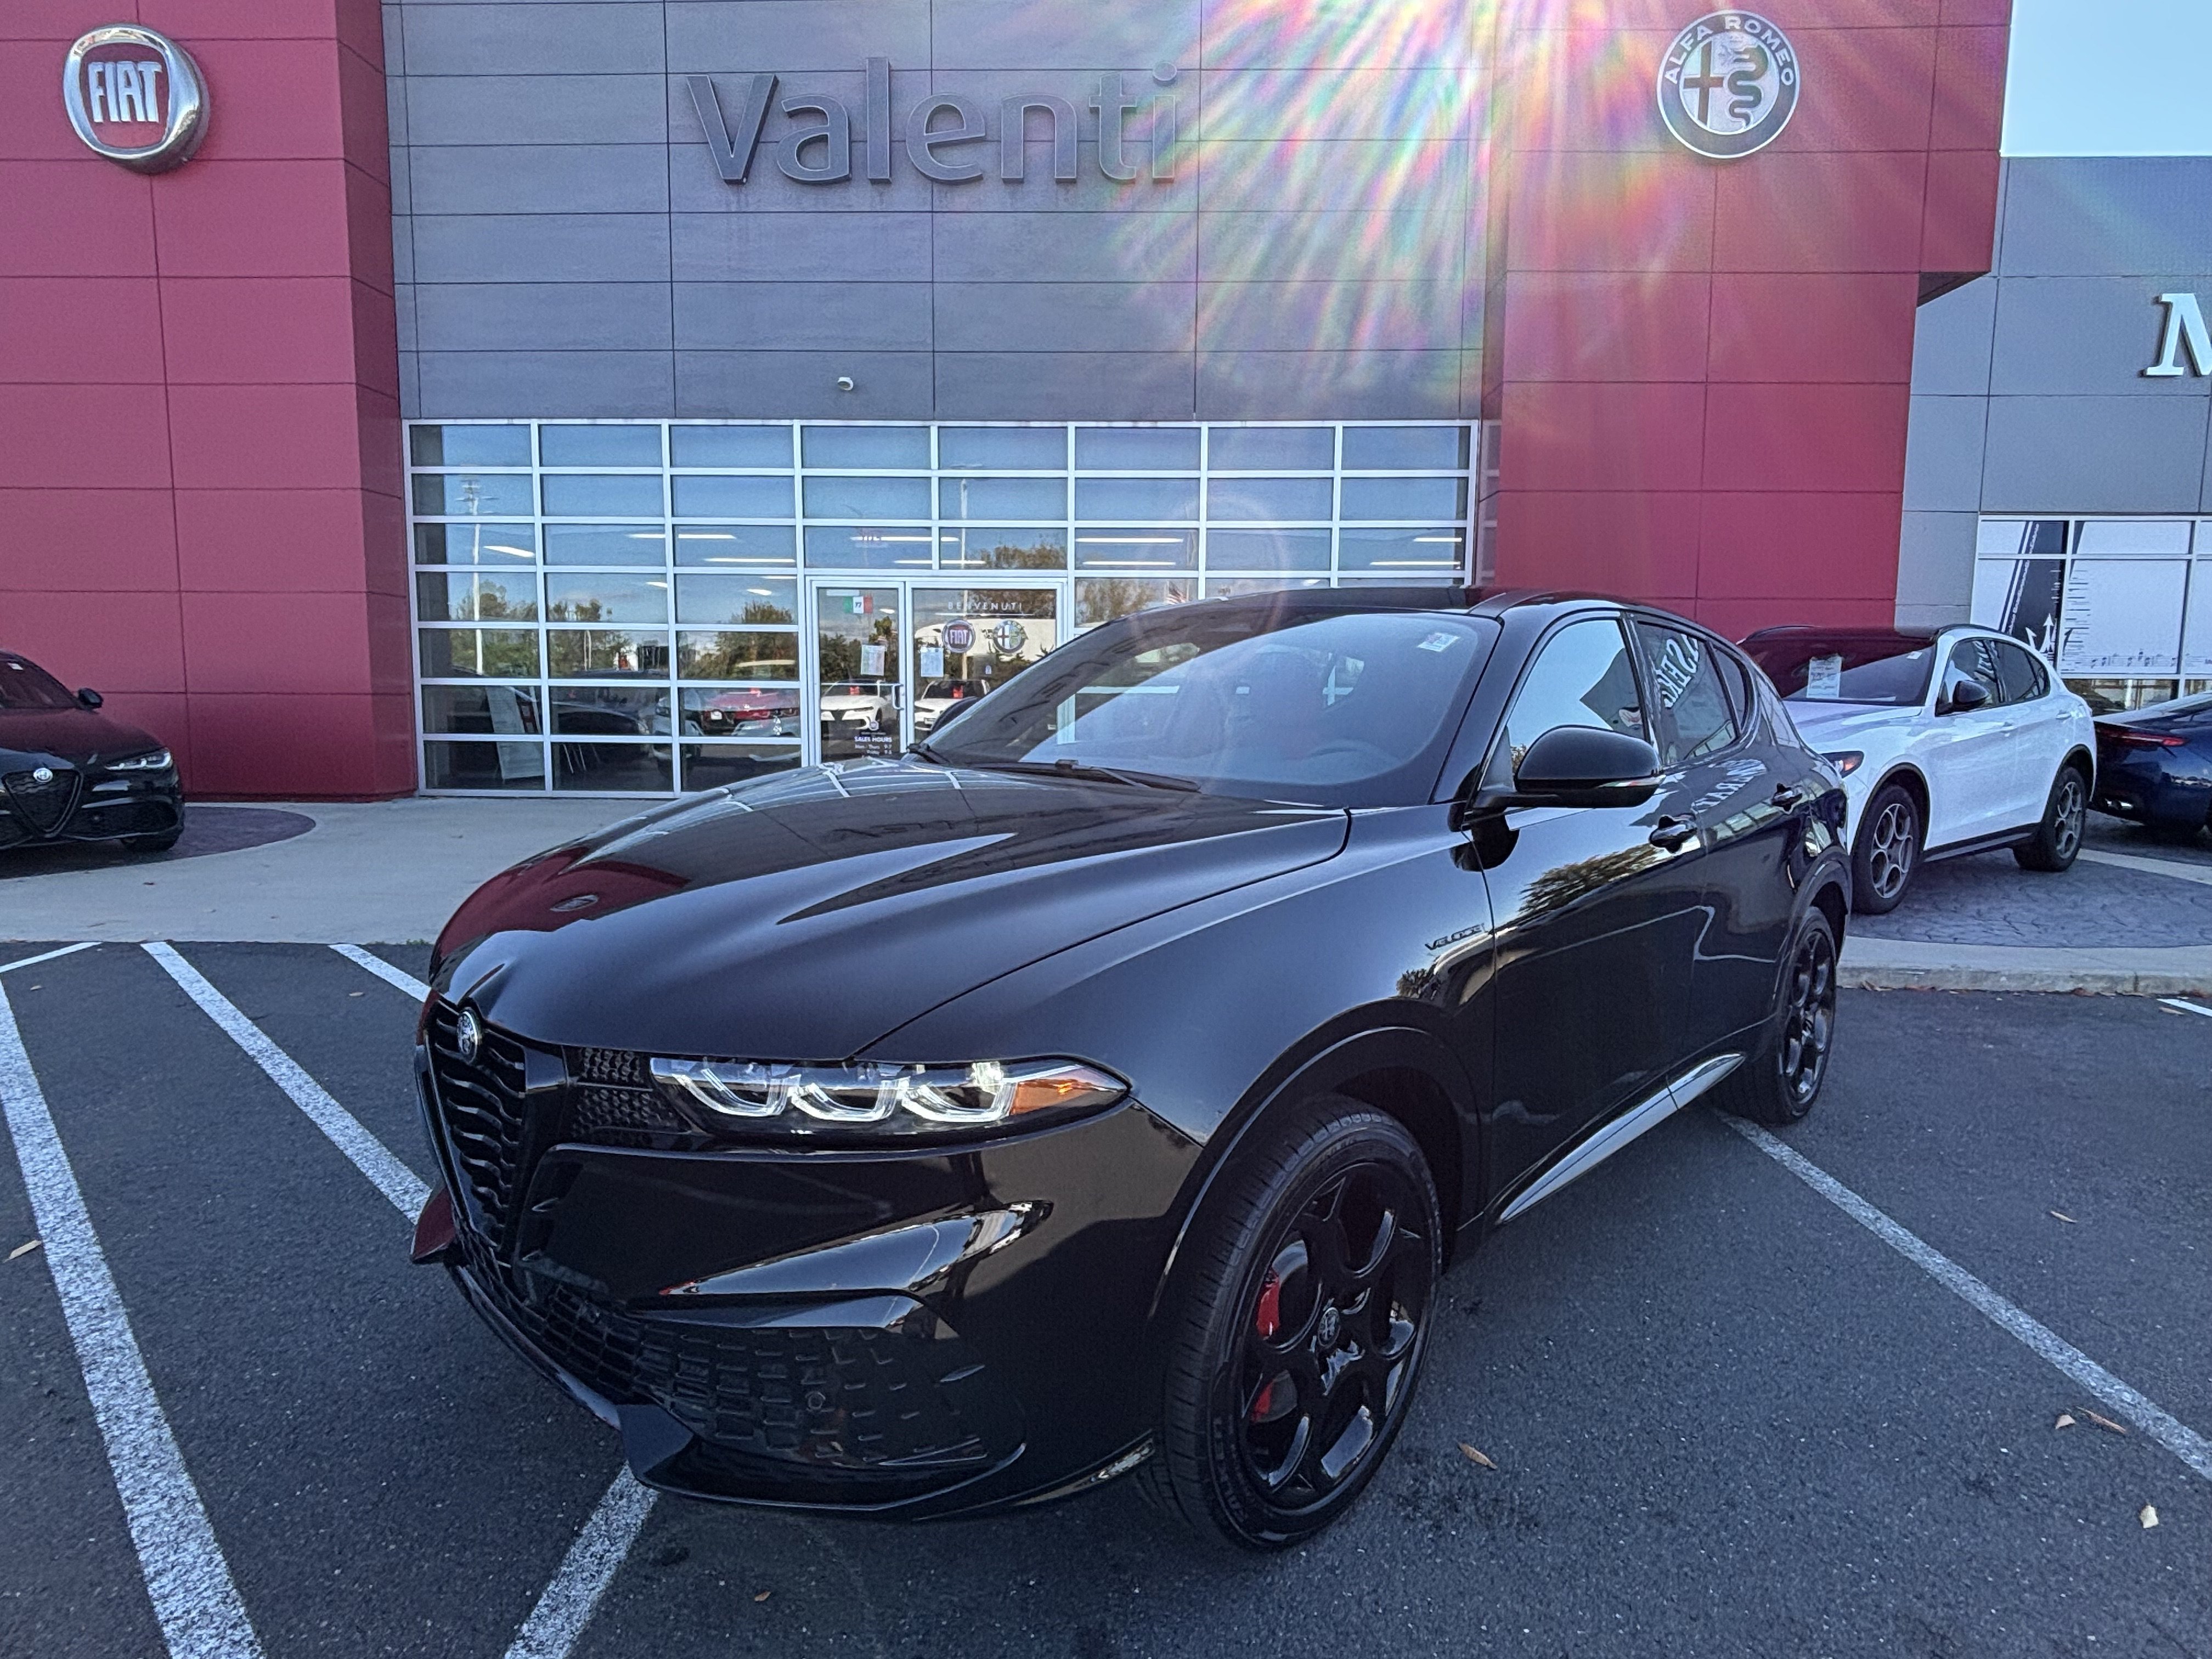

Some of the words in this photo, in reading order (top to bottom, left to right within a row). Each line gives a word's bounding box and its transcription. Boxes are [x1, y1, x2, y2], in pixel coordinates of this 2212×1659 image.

[1664, 24, 1713, 84] ALFA
[1724, 15, 1794, 86] ROMEO
[87, 60, 163, 123] FIAT
[686, 57, 1176, 185] Valenti
[949, 629, 969, 645] FIAT
